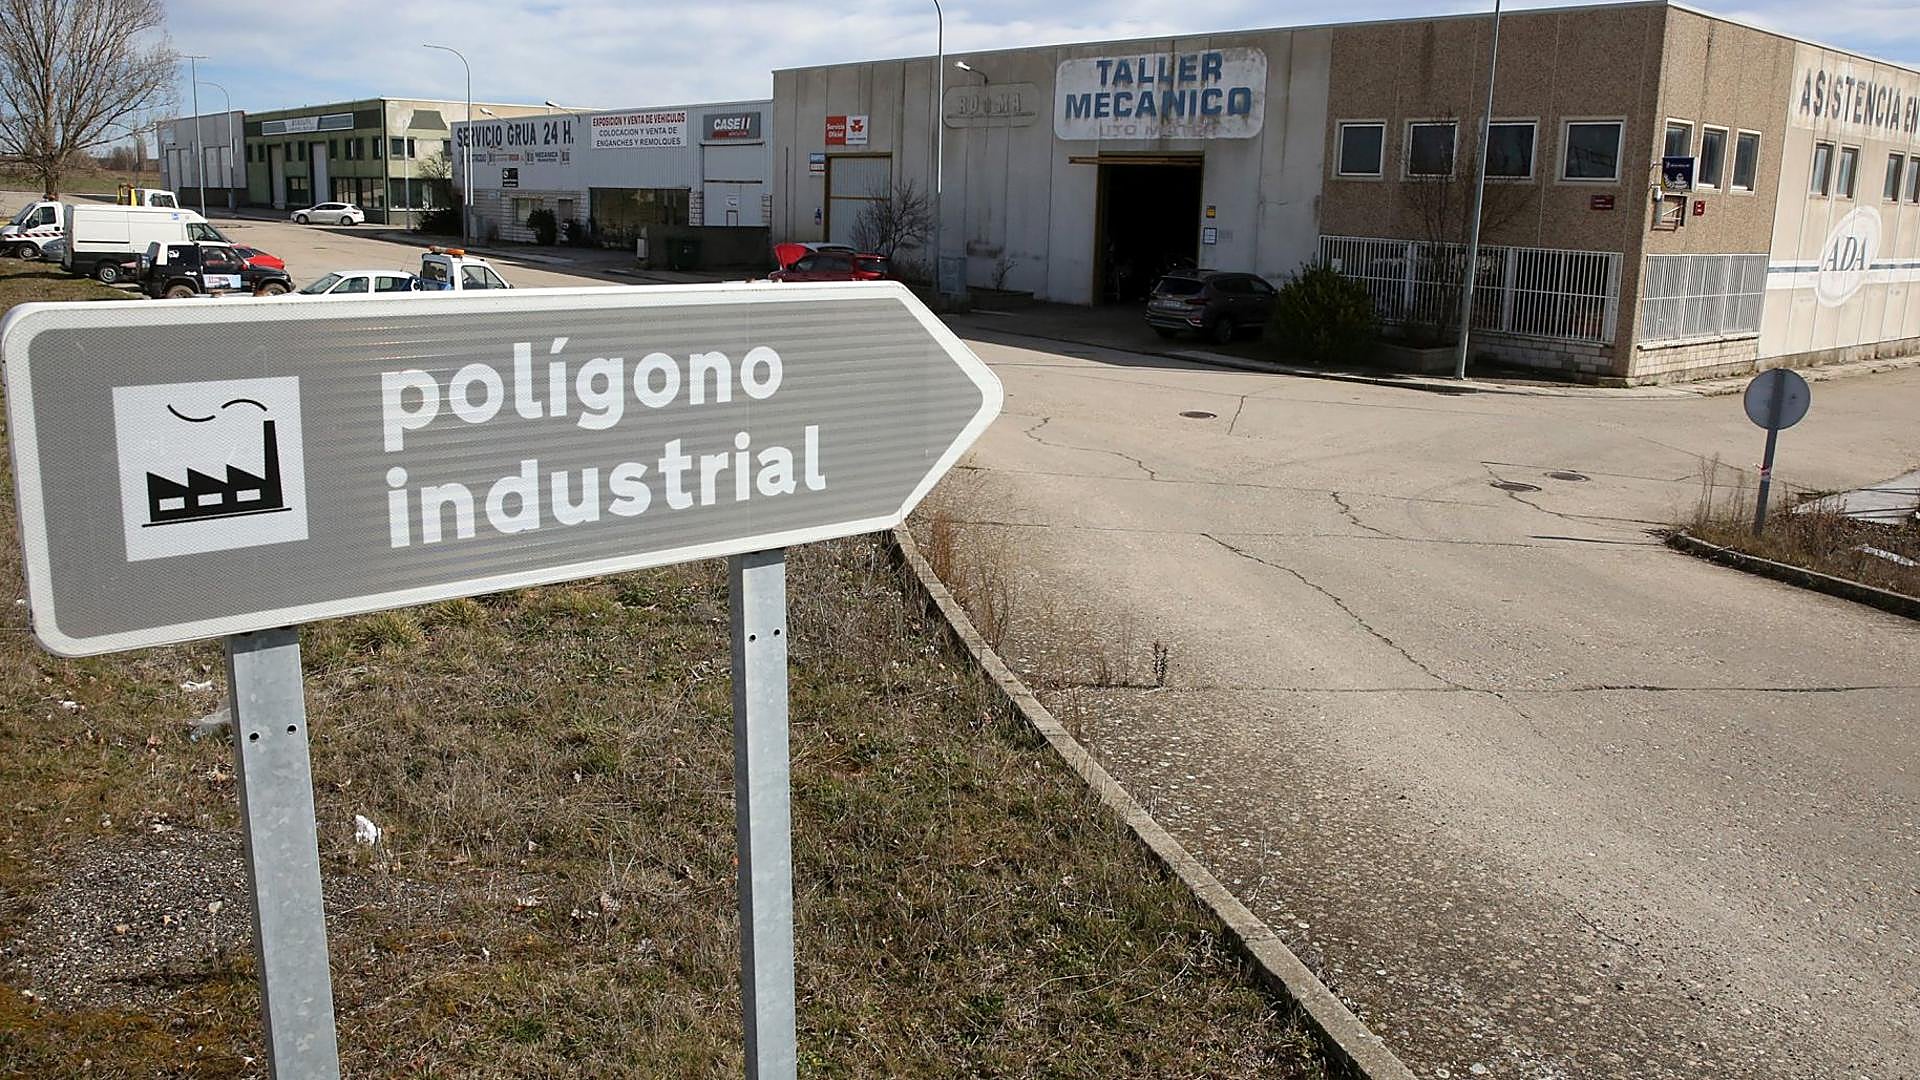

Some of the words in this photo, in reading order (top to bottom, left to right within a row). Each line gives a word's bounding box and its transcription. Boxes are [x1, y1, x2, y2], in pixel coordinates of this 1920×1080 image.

[1097, 53, 1223, 87] TALLER
[1065, 87, 1252, 121] MECANICO
[1800, 69, 1902, 131] ASISTENCIA
[457, 125, 503, 148] SERVICIO
[507, 122, 537, 146] GRUA
[543, 120, 559, 145] 24
[563, 120, 575, 145] H.
[592, 116, 622, 126] EXPOSICION
[628, 114, 645, 125] VENTA
[645, 113, 654, 124] DE
[654, 112, 685, 124] VEHICULOS
[599, 129, 639, 137] COLOCACION
[646, 127, 667, 135] VENTA
[668, 126, 678, 134] DE
[713, 118, 740, 130] CASE
[640, 138, 681, 146] REMOLQUES
[1823, 236, 1868, 272] ADA
[380, 336, 784, 453] polígono
[385, 424, 828, 549] industrial
